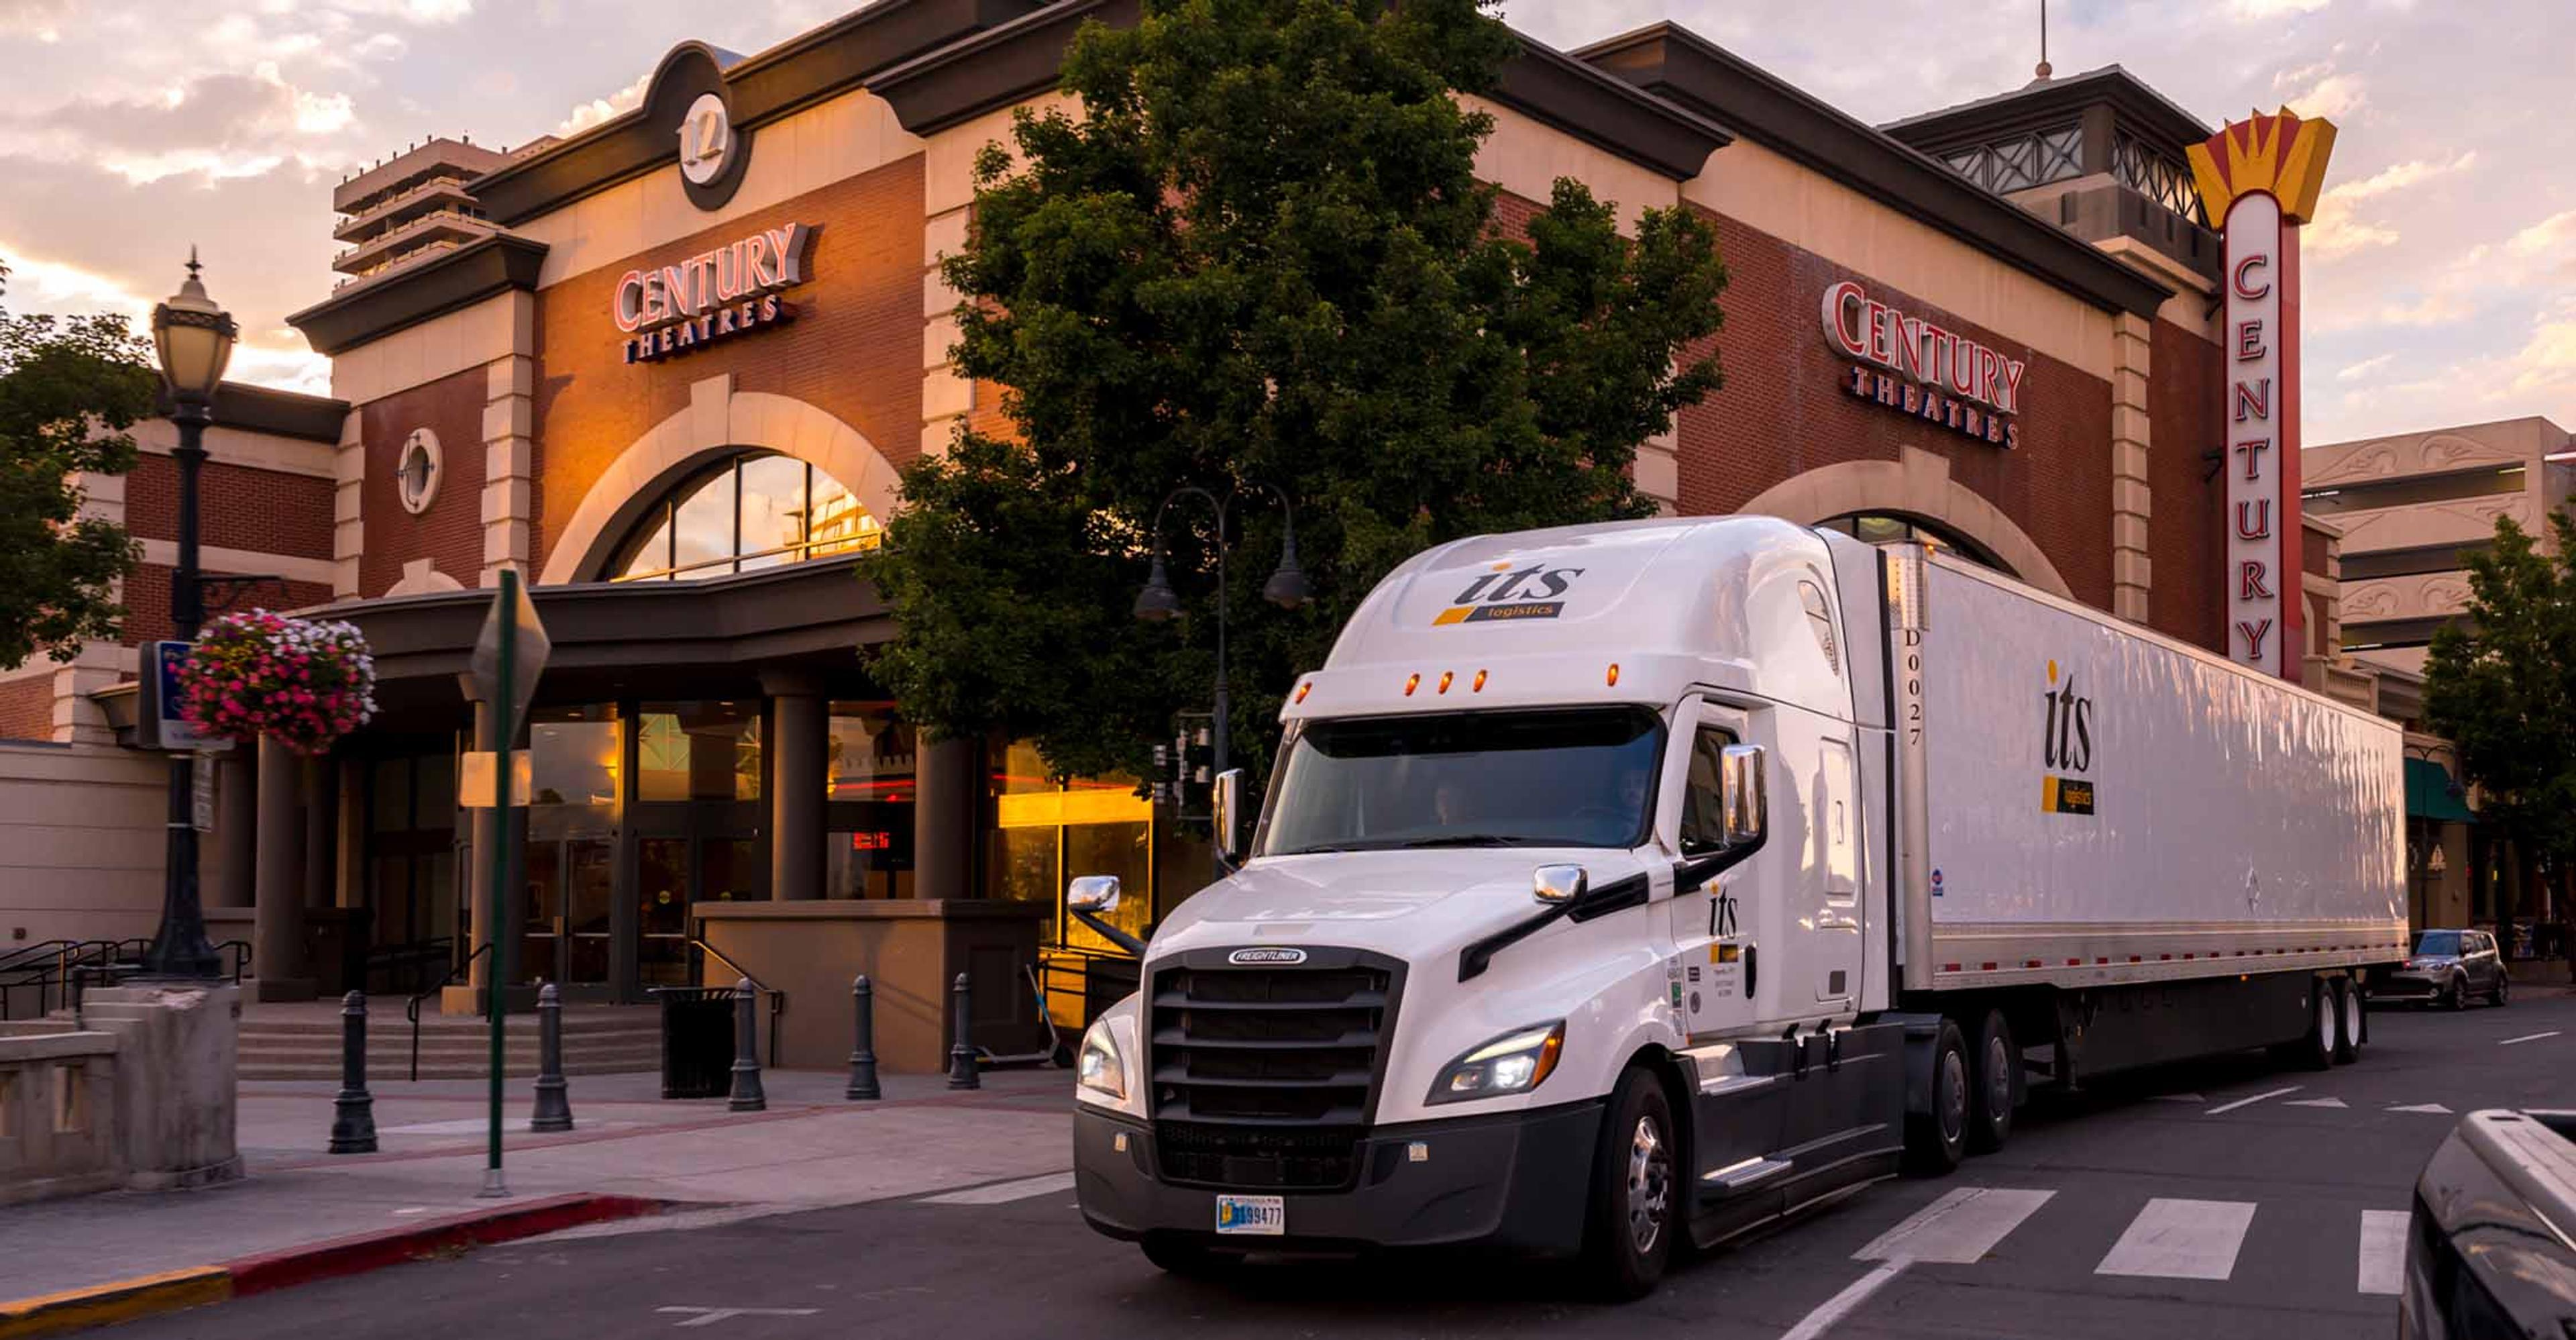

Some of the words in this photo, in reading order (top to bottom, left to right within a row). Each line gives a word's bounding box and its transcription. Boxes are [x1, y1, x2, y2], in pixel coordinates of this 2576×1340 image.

[613, 222, 808, 333] CENTURY
[622, 295, 781, 364] THEATRES
[1822, 281, 2025, 414] CENTURY
[1851, 366, 2019, 450] THEATRES
[2234, 254, 2274, 660] CENTURY
[1454, 563, 1585, 605] its
[1488, 605, 1554, 617] logistics
[1906, 629, 1921, 745] D0027
[2045, 660, 2092, 772] its
[1710, 881, 1737, 939] its
[1235, 951, 1300, 962] FREIGHTLINER
